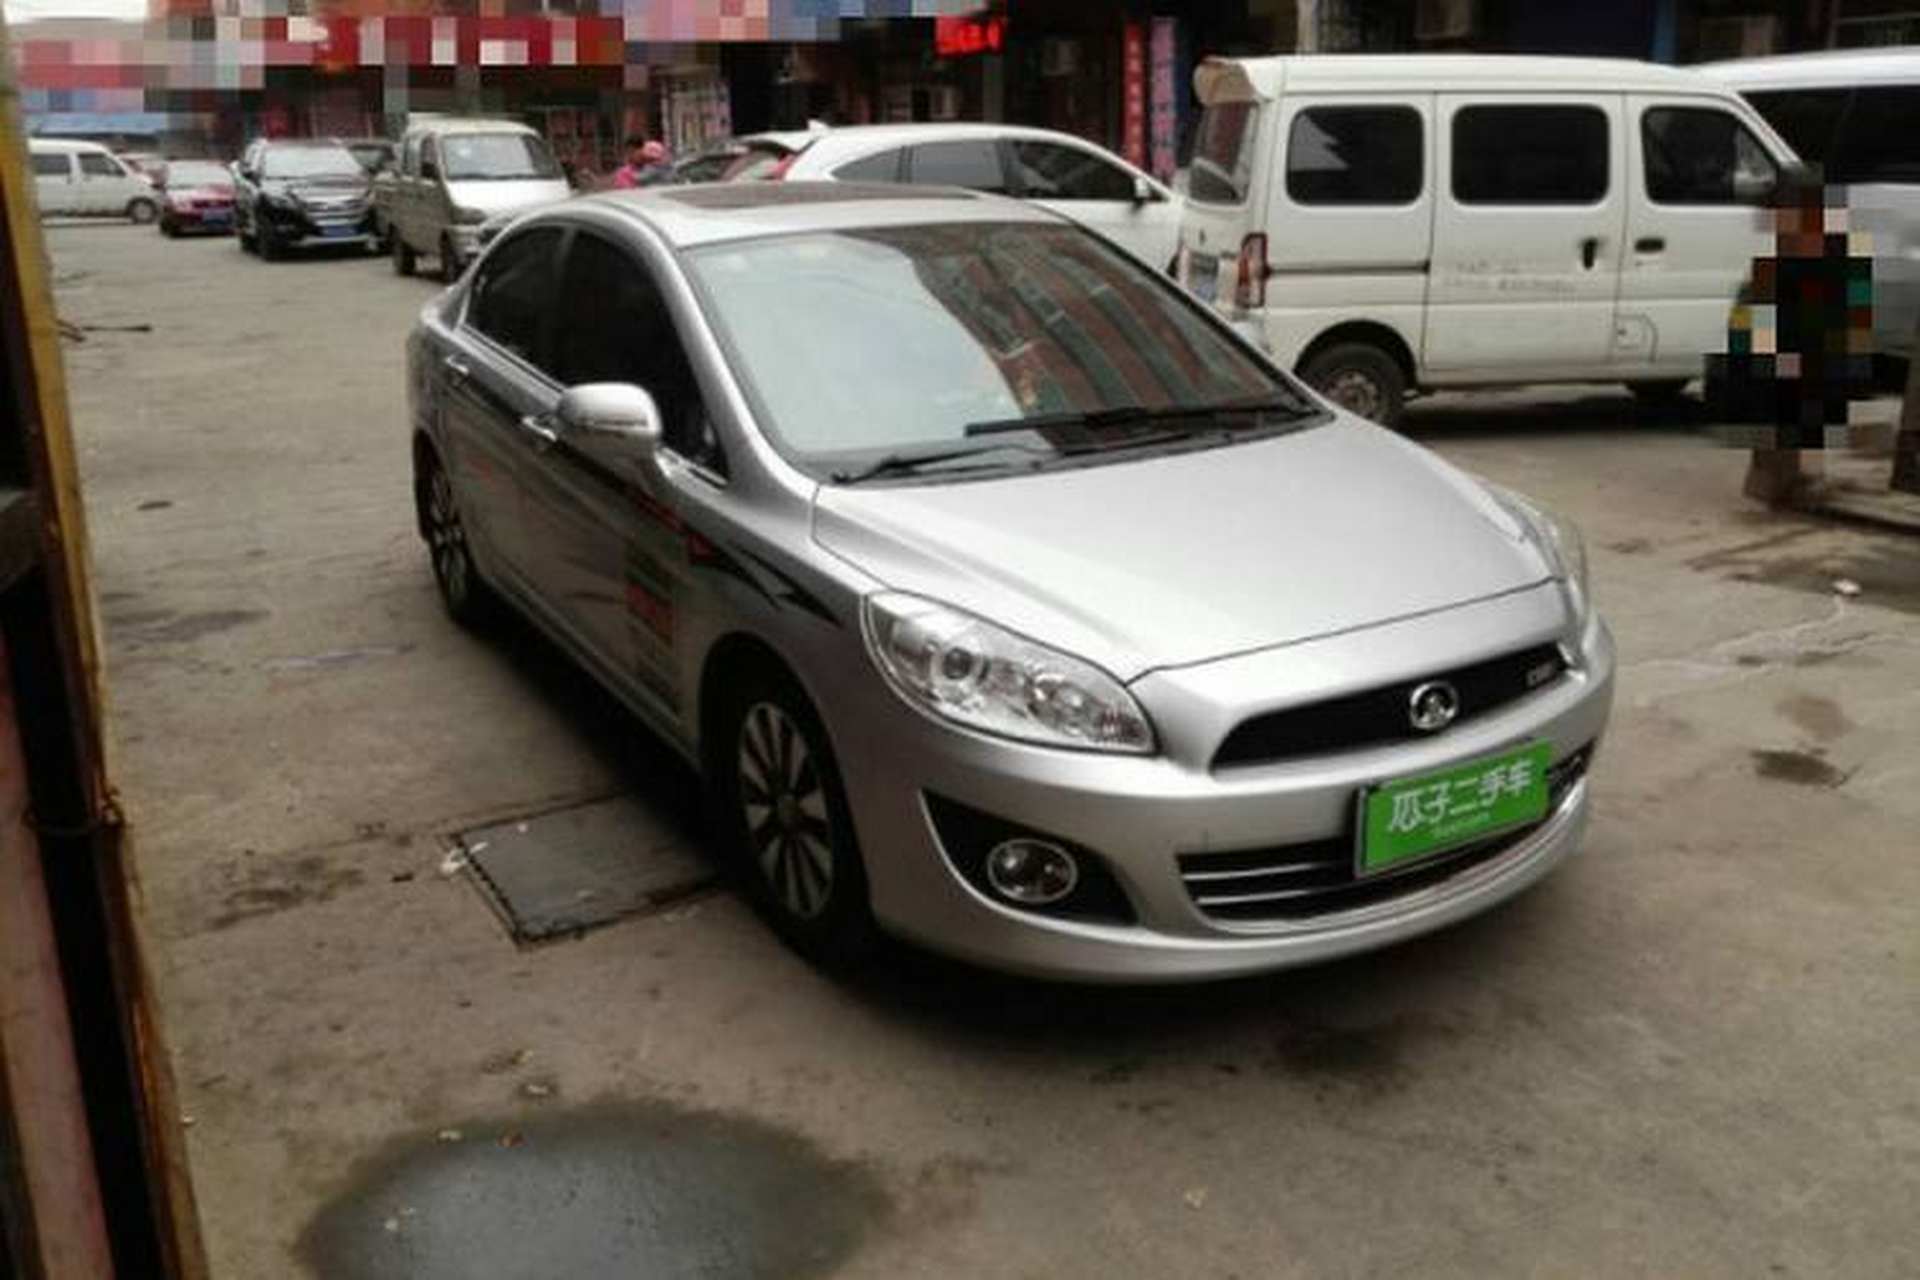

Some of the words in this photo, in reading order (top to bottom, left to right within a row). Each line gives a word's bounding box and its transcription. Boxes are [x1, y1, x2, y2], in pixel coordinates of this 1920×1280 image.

[1388, 760, 1532, 832] 瓜子二手车
